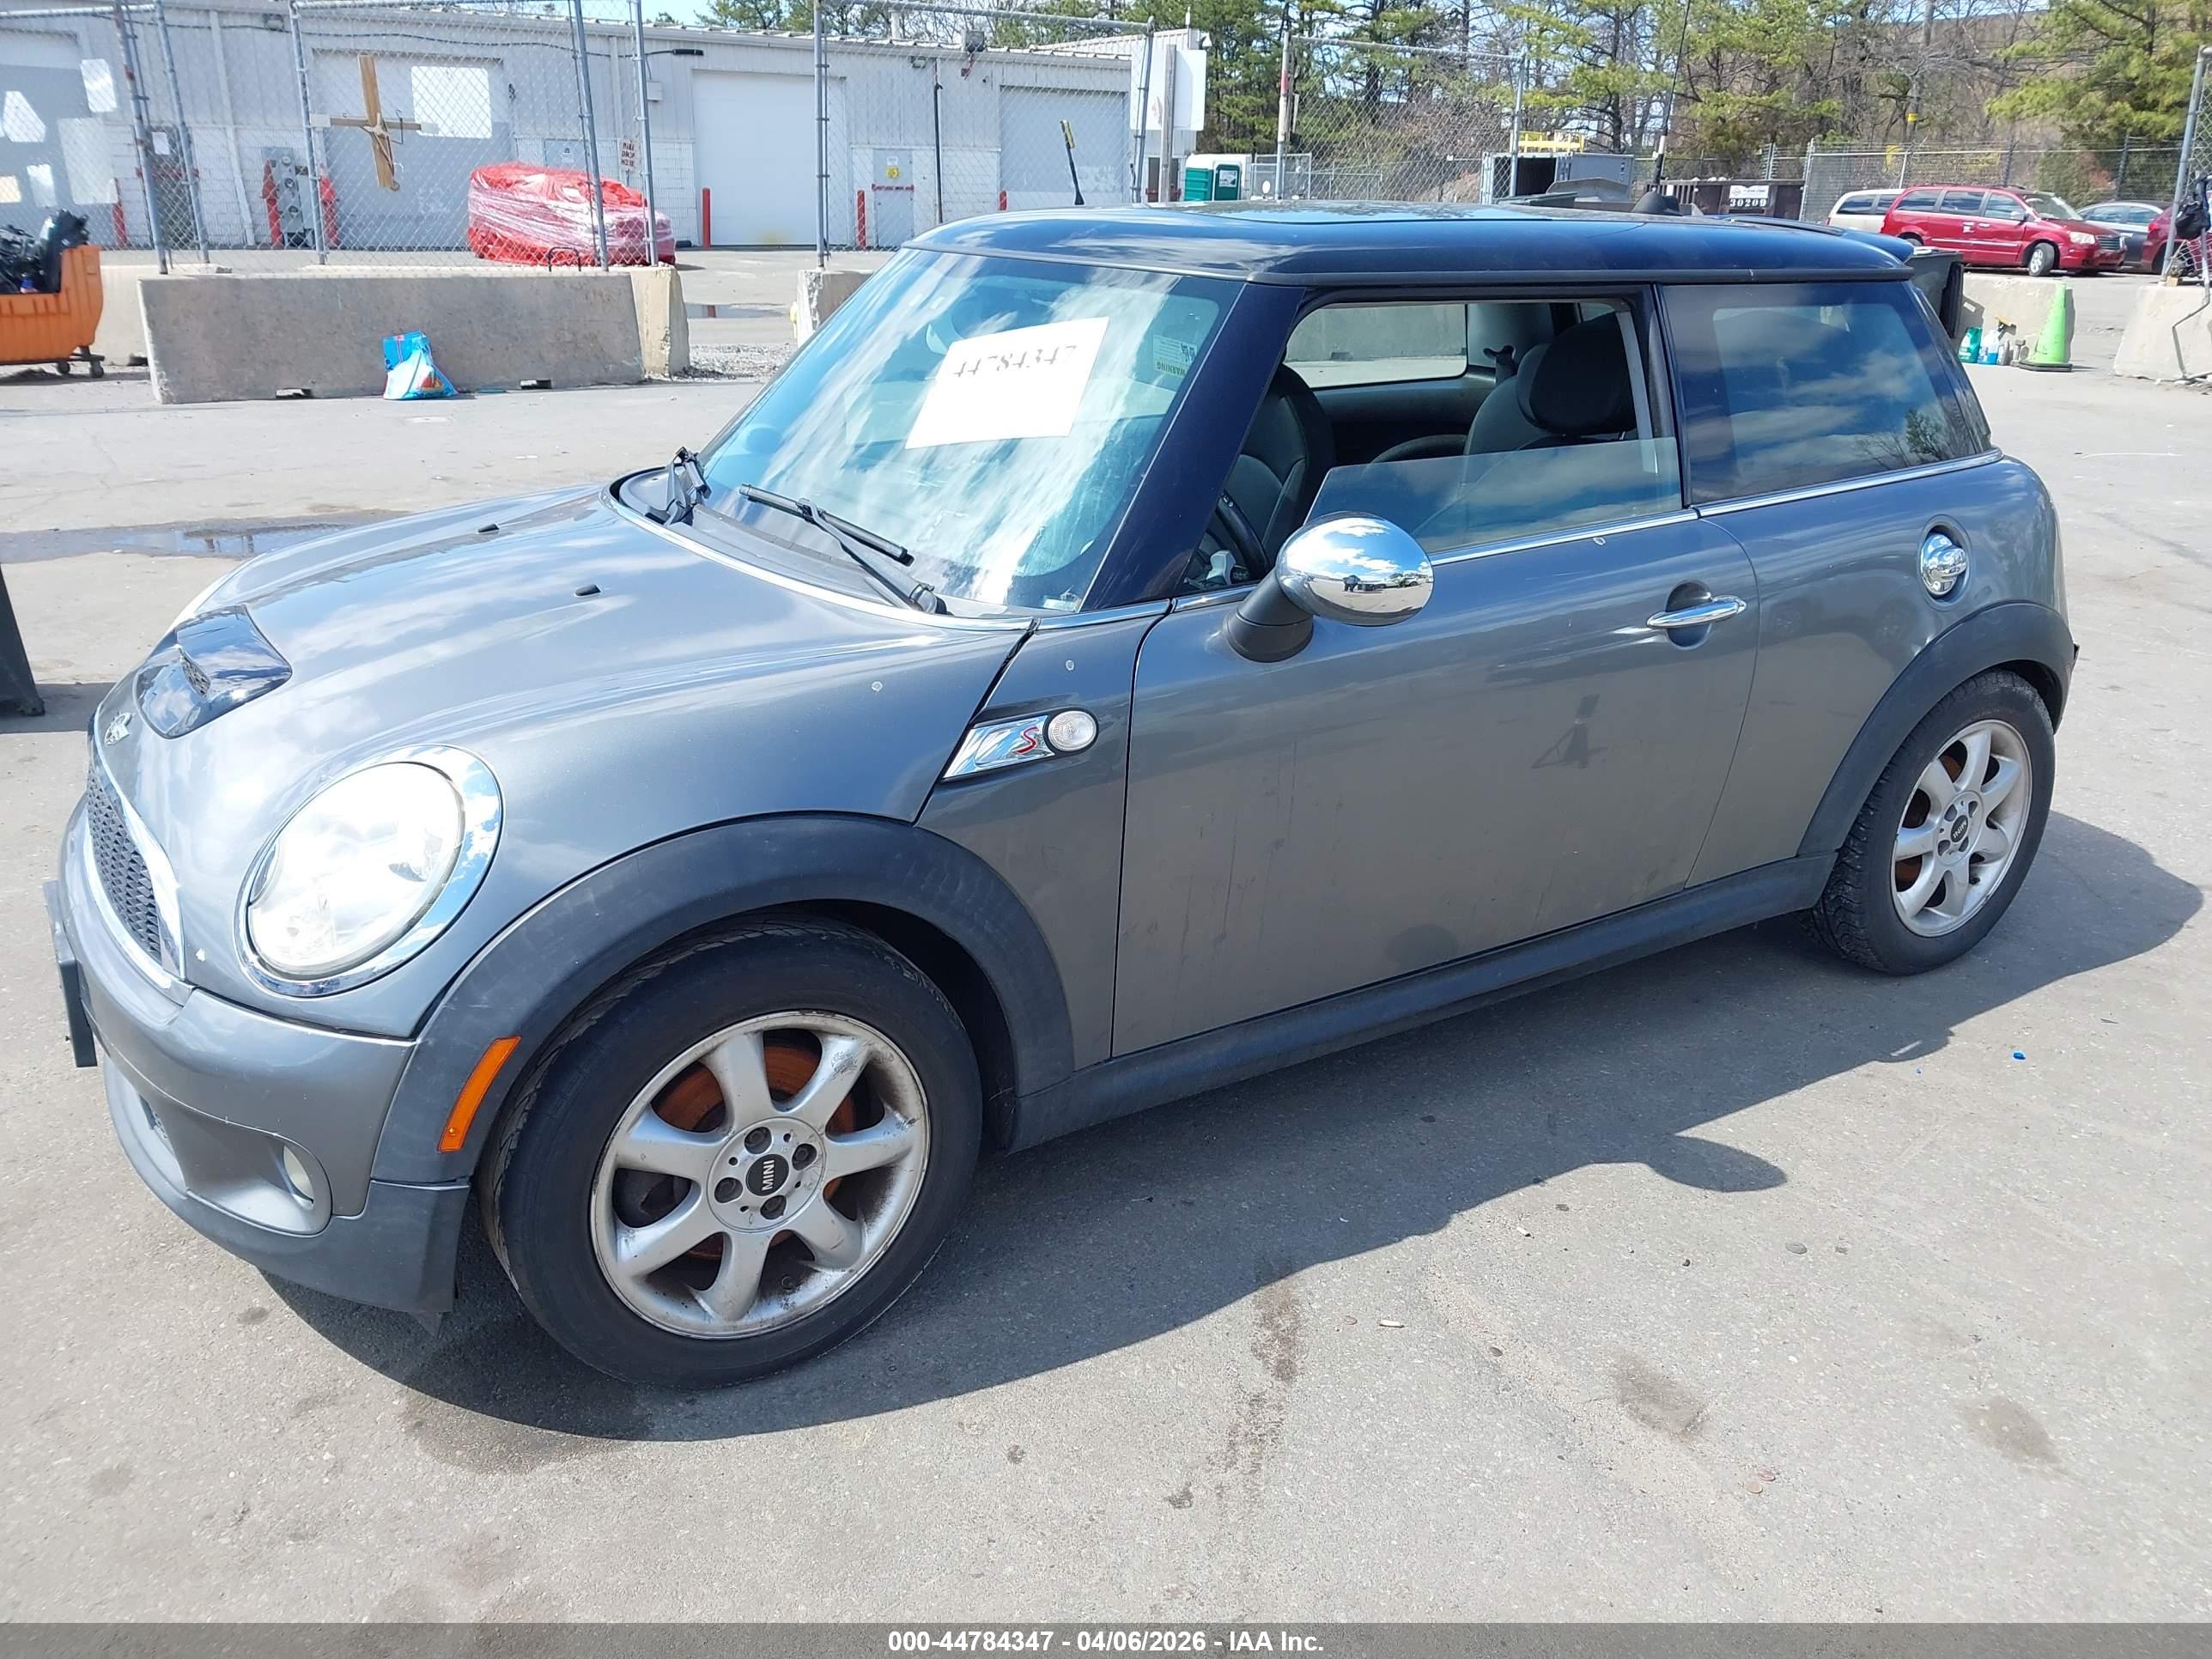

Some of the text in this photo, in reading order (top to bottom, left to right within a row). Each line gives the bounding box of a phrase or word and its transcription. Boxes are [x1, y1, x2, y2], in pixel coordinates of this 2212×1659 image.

[1729, 198, 1767, 207] 30209
[1156, 362, 1186, 376] WARNING
[1017, 726, 1039, 755] S
[762, 1159, 775, 1191] MINI
